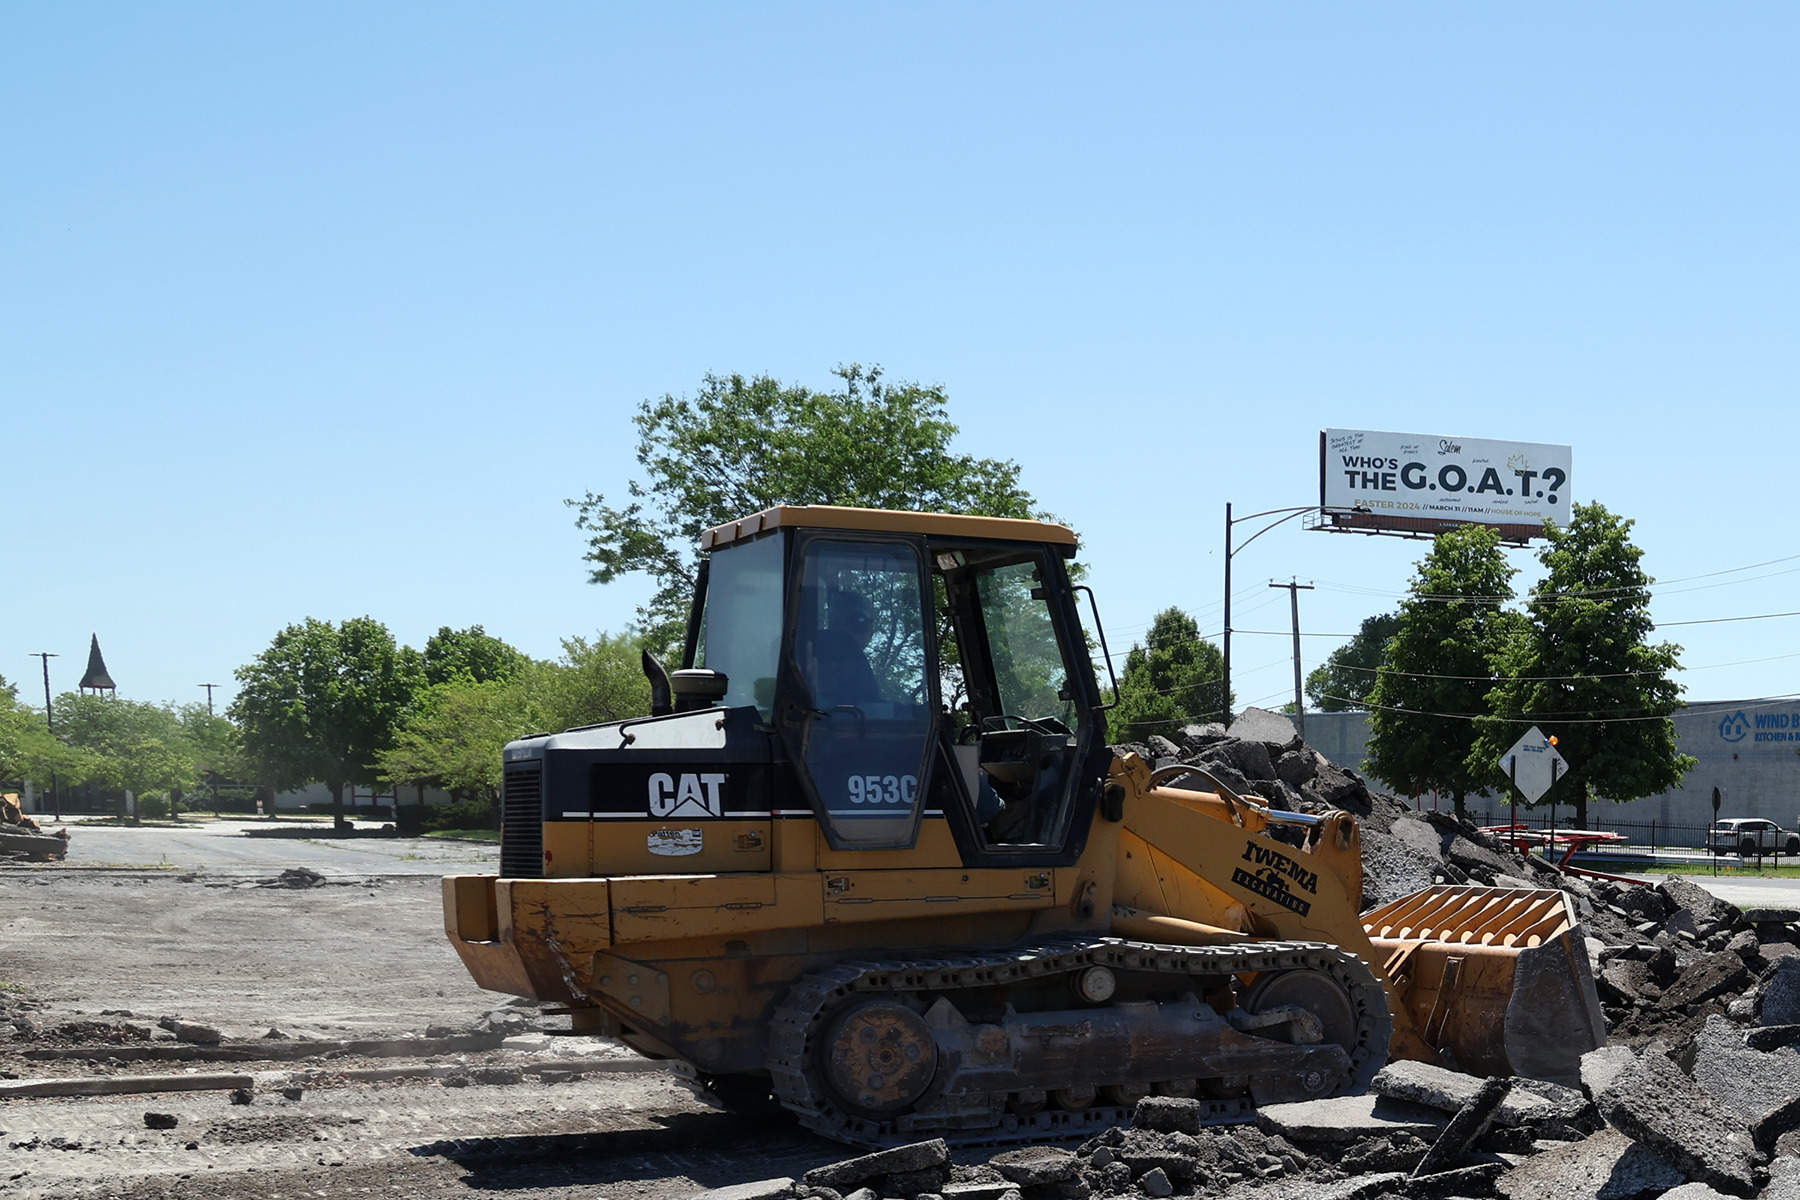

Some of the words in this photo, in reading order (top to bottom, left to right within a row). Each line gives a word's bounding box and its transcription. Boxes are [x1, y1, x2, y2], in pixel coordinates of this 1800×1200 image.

[1342, 455, 1398, 470] WHO'S
[1344, 470, 1397, 491] THE
[1400, 462, 1566, 505] G.O.A.T.?
[1354, 499, 1394, 509] EASTER
[1396, 502, 1420, 510] 2024
[1429, 504, 1453, 512] MARCH
[1755, 712, 1789, 728] WIND
[1754, 731, 1787, 742] KITCHEN
[648, 772, 726, 817] CAT
[847, 774, 918, 803] 953C
[1241, 840, 1319, 895] IWEMA
